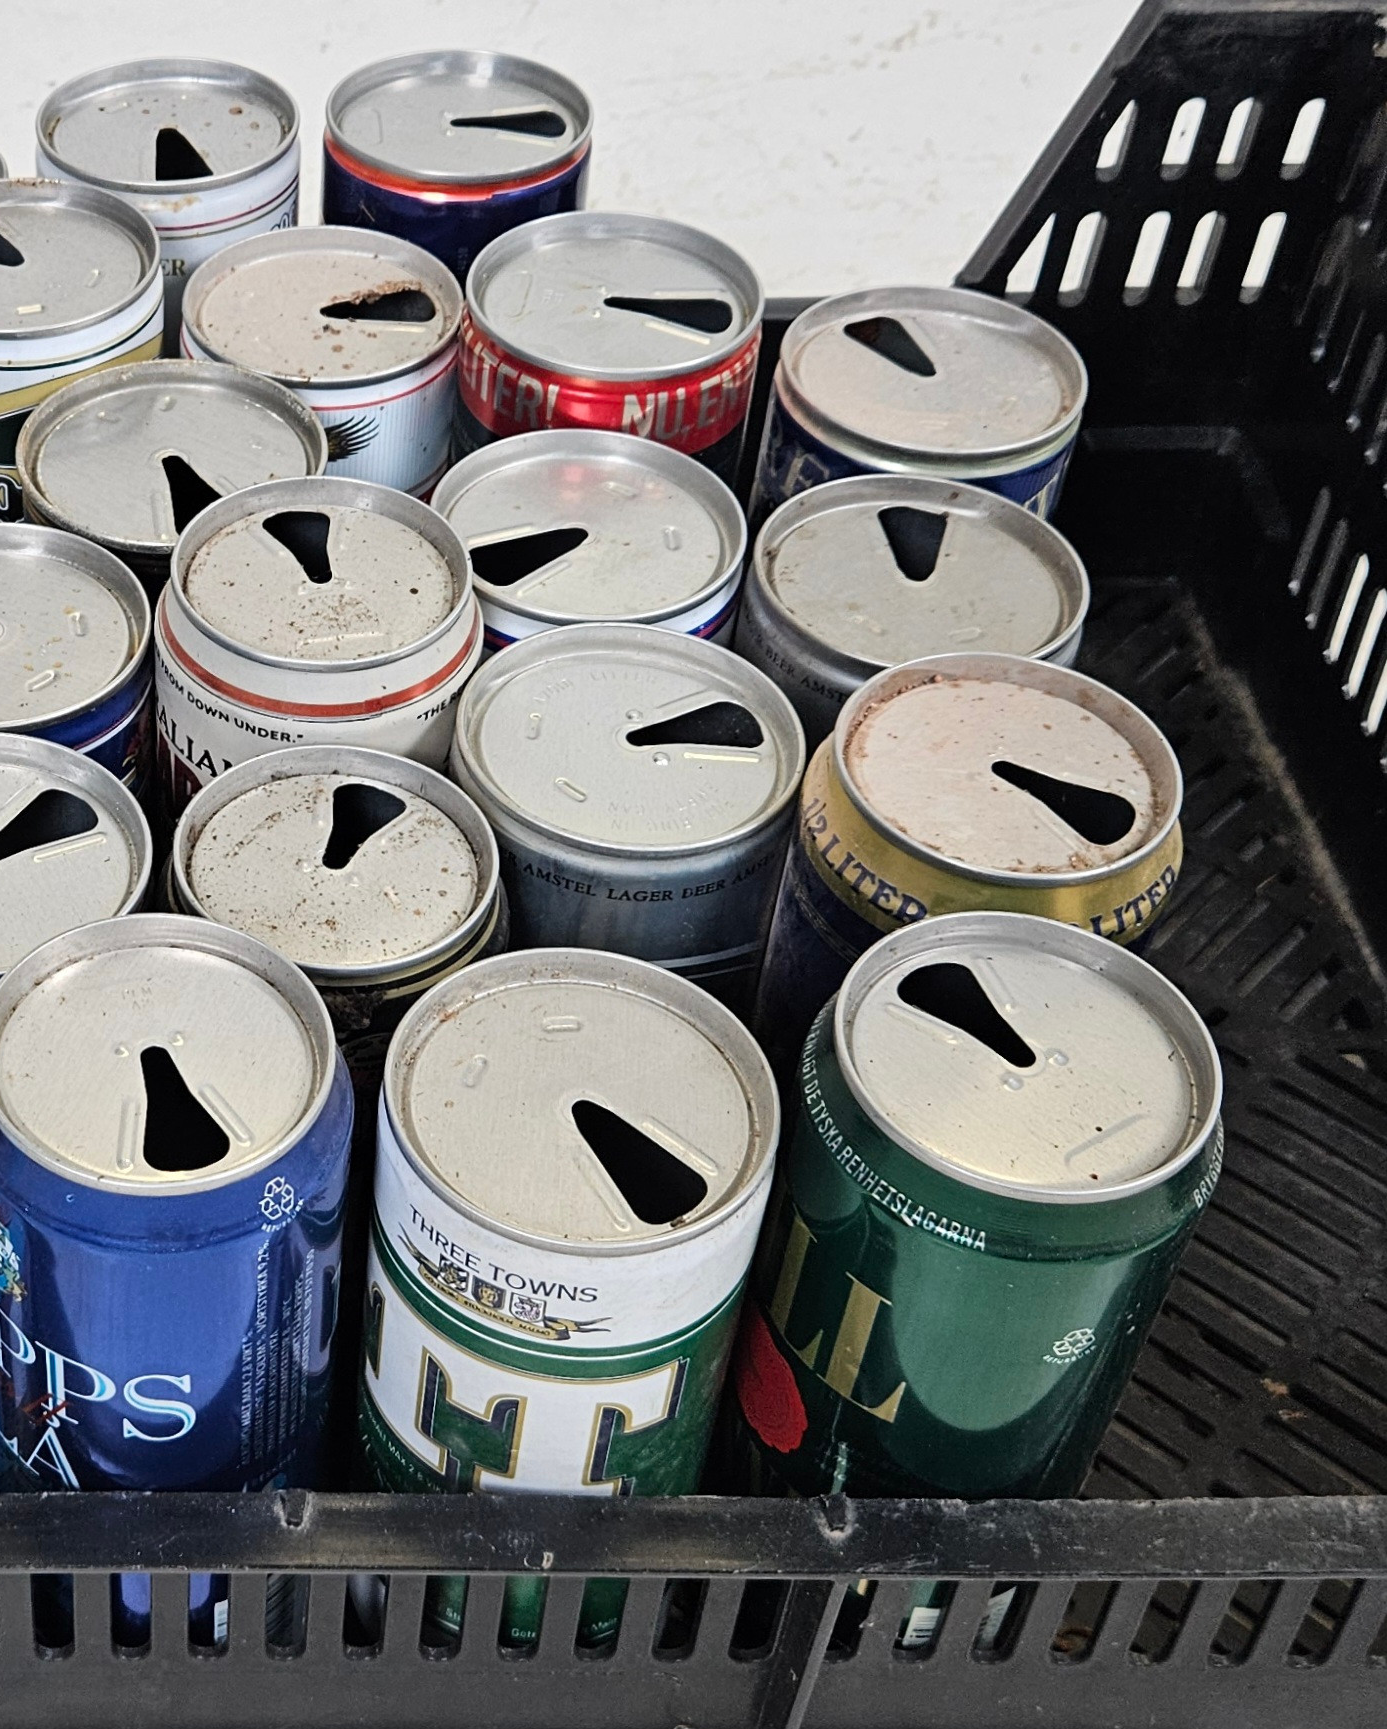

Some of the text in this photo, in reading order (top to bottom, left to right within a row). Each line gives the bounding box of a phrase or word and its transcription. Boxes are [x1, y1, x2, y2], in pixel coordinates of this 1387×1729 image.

[187, 691, 230, 723] DOWN
[522, 861, 598, 898] AMSTEL
[605, 886, 675, 904] LAGER
[680, 876, 727, 900] BEER
[820, 834, 929, 923] LITER
[804, 1078, 822, 1105] DE
[810, 1099, 844, 1153] TYSKA
[408, 1203, 599, 1304] THREE TOWNS
